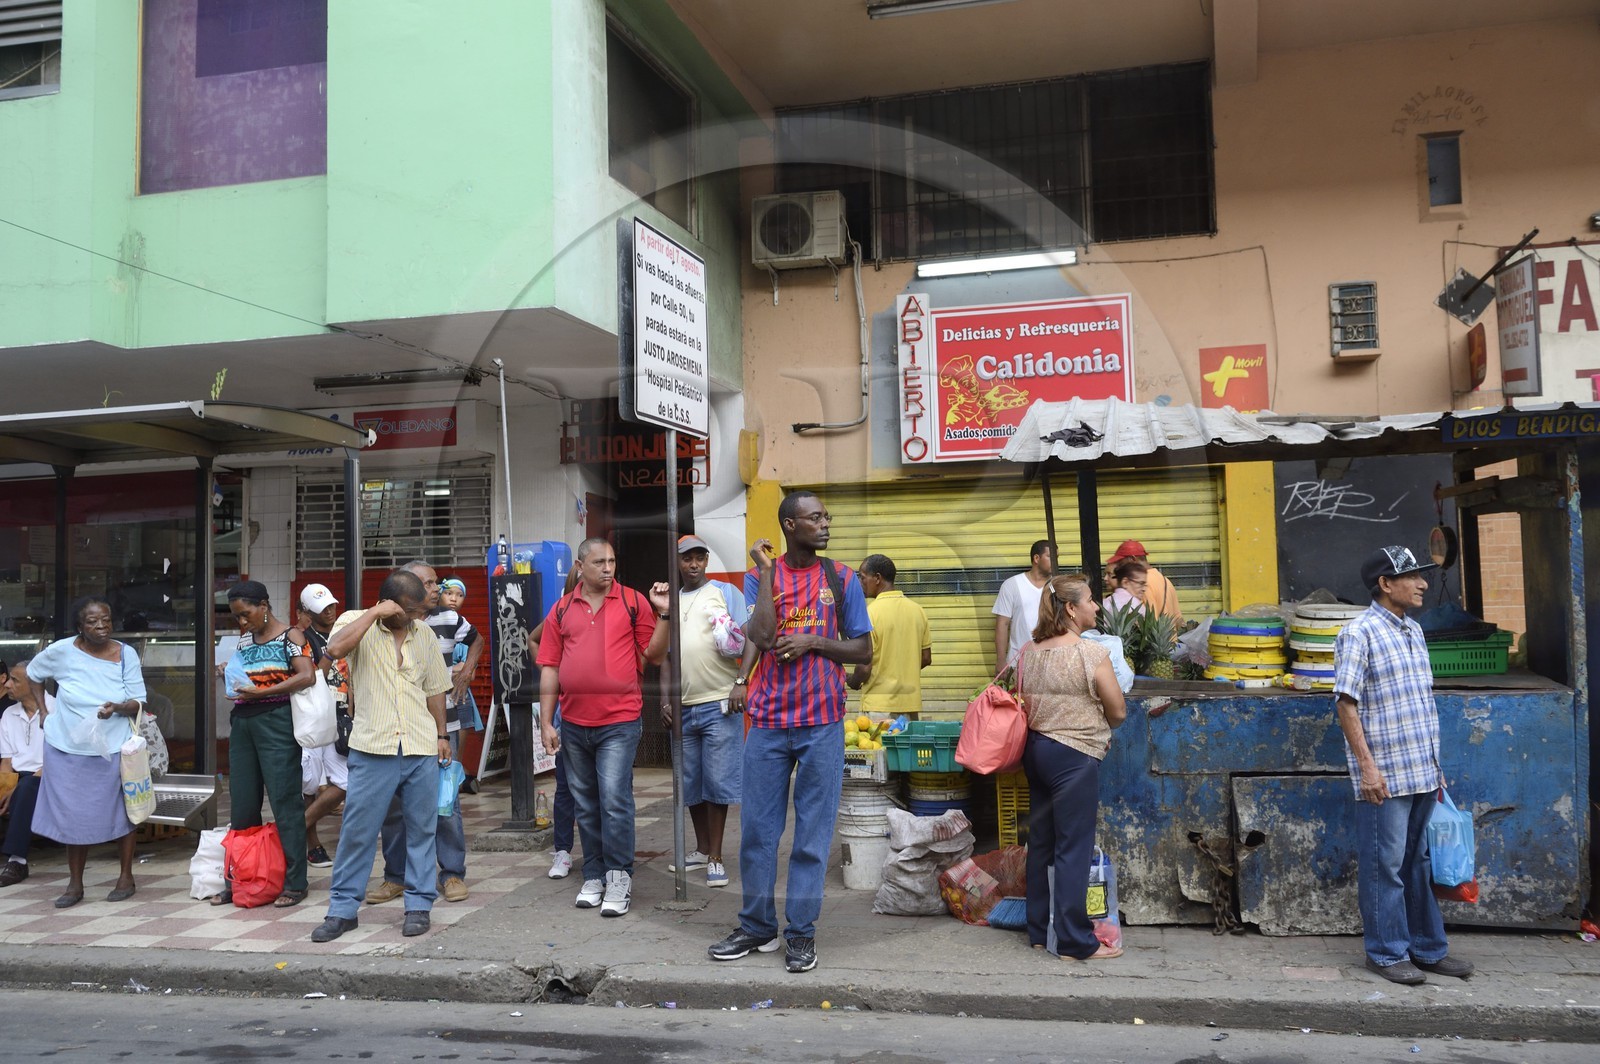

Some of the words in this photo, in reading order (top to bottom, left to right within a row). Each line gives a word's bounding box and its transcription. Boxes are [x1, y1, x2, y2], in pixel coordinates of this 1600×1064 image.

[640, 228, 646, 244] A
[647, 235, 664, 255] partir
[665, 244, 675, 264] del
[675, 250, 680, 265] 7
[681, 256, 701, 277] agosto.
[645, 260, 656, 276] vas
[657, 264, 674, 287] hacia
[675, 275, 684, 292] las
[685, 282, 705, 305] afueras
[651, 291, 661, 306] por
[662, 294, 678, 314] Calle
[679, 303, 688, 323] 50,
[689, 308, 695, 323] tu
[646, 316, 667, 336] parada
[669, 327, 687, 345] estará
[688, 337, 695, 349] en
[696, 337, 702, 352] la
[942, 326, 1002, 343] Delicias
[1005, 327, 1015, 340] y
[1019, 317, 1120, 338] Refresquería
[644, 340, 665, 362] JUSTO
[666, 349, 703, 378] AROSEMENA
[976, 348, 1122, 381] Calidonia
[901, 295, 928, 461] ABIERTO
[658, 401, 666, 416] de
[667, 404, 673, 418] la
[674, 404, 692, 425] C.S.S.
[1452, 418, 1501, 439] DIOS
